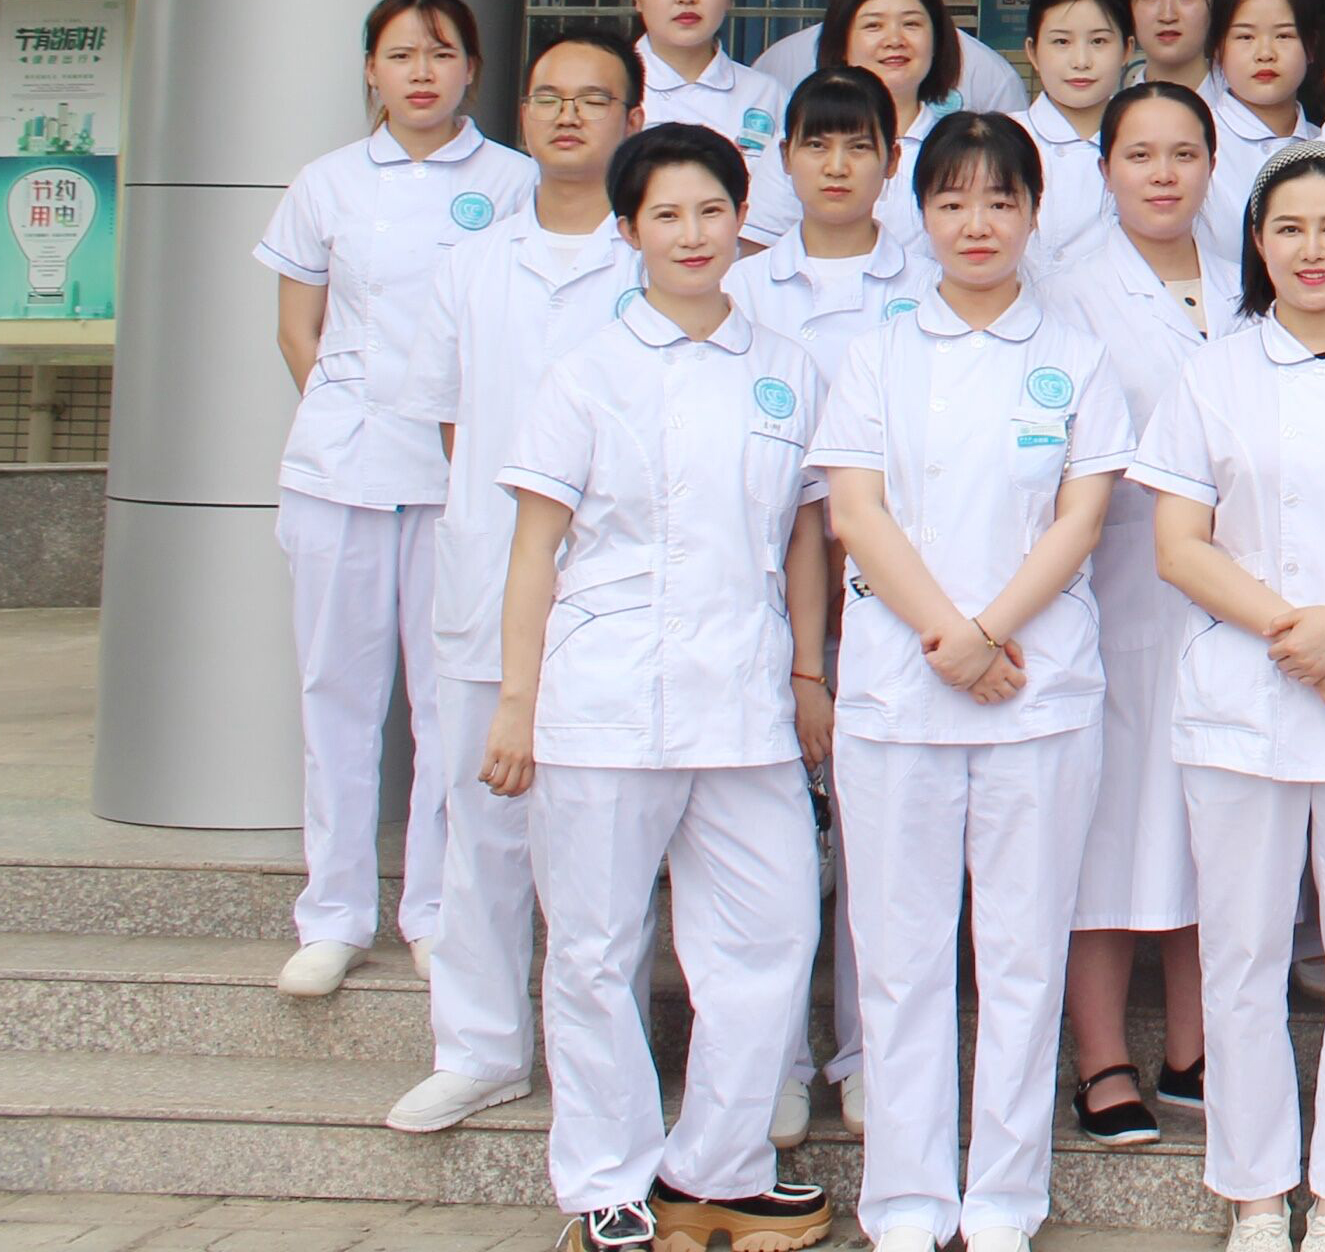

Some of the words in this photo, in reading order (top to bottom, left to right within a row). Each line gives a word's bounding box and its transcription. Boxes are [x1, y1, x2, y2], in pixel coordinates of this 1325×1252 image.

[15, 26, 107, 51] 节能减排
[32, 179, 77, 201] 节约
[30, 205, 80, 228] 用电
